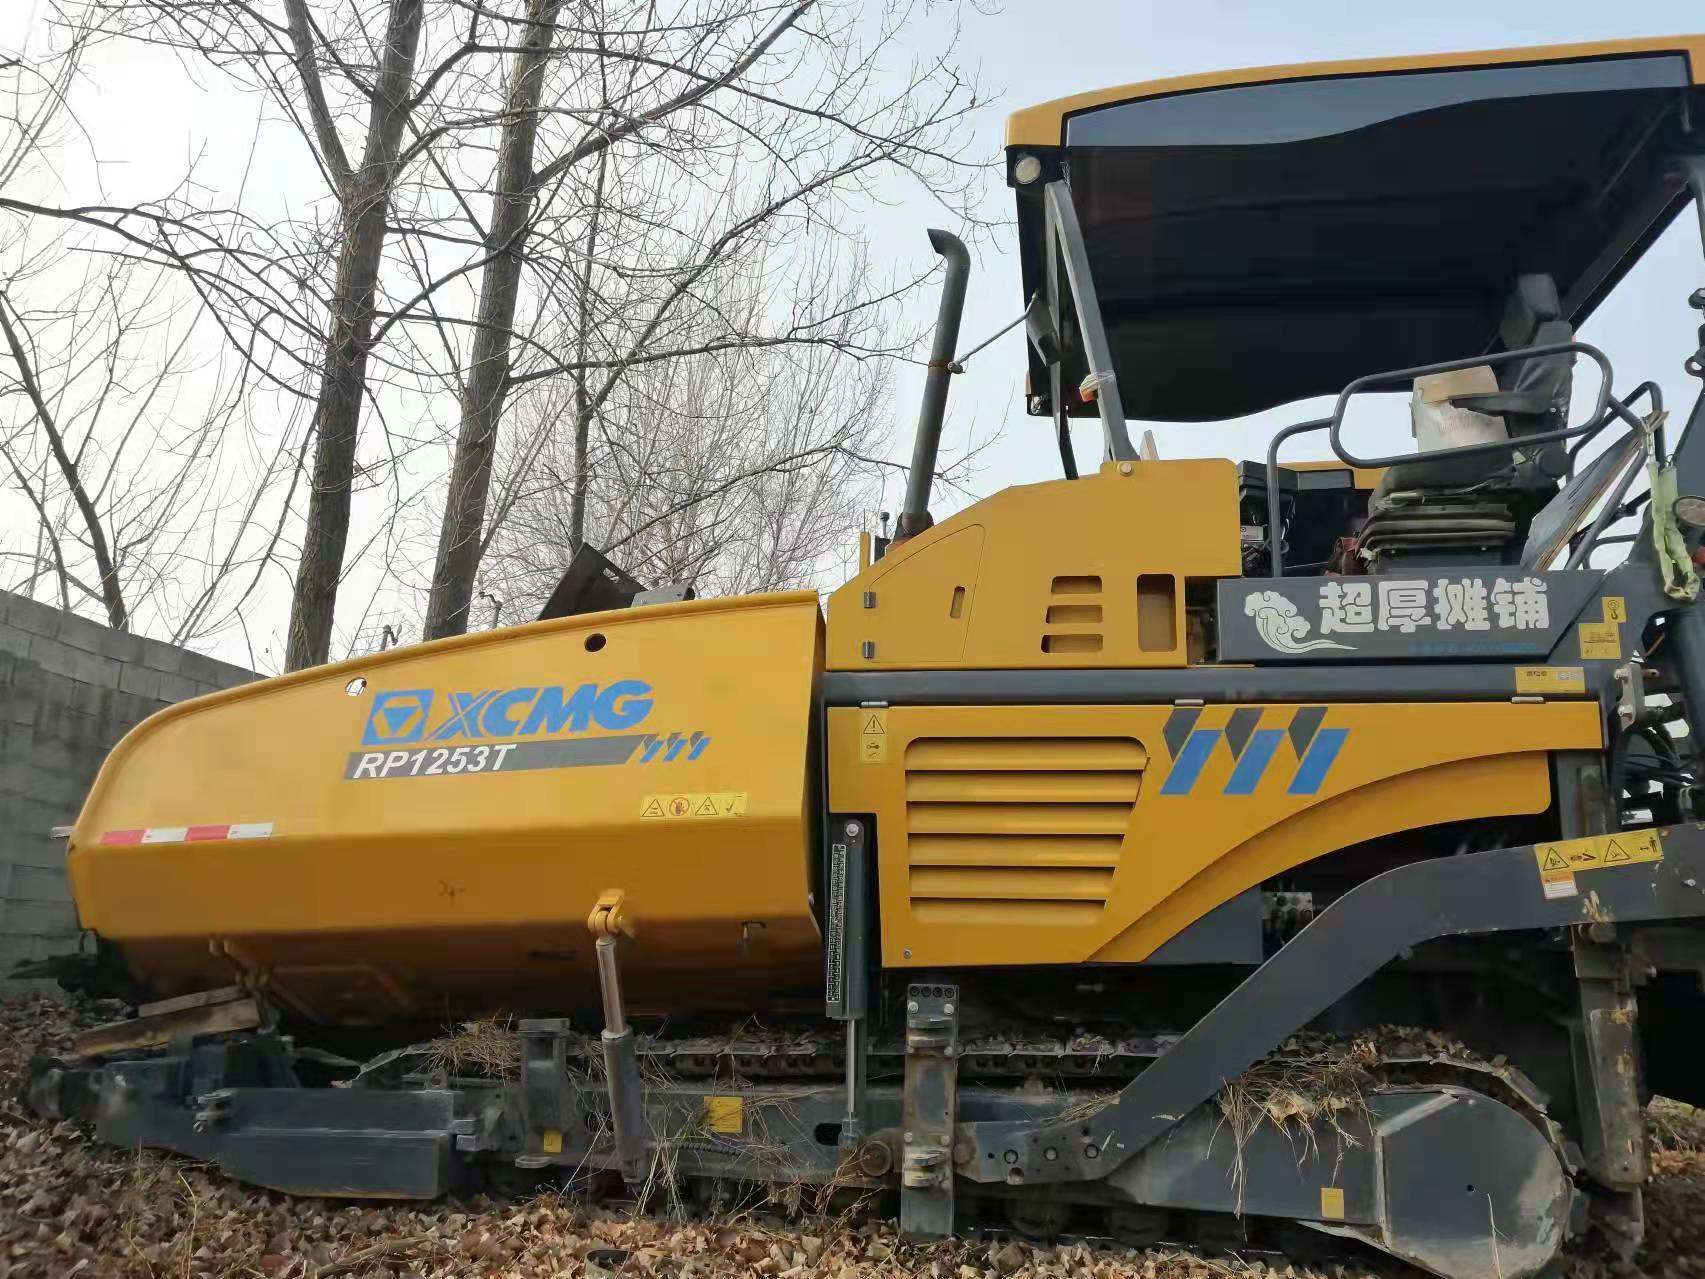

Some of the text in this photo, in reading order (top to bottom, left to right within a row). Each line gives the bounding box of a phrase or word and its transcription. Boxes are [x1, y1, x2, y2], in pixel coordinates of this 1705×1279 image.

[1318, 578, 1550, 634] 超厚摊铺
[424, 680, 654, 740] XCMG
[353, 744, 517, 779] RP1253T
